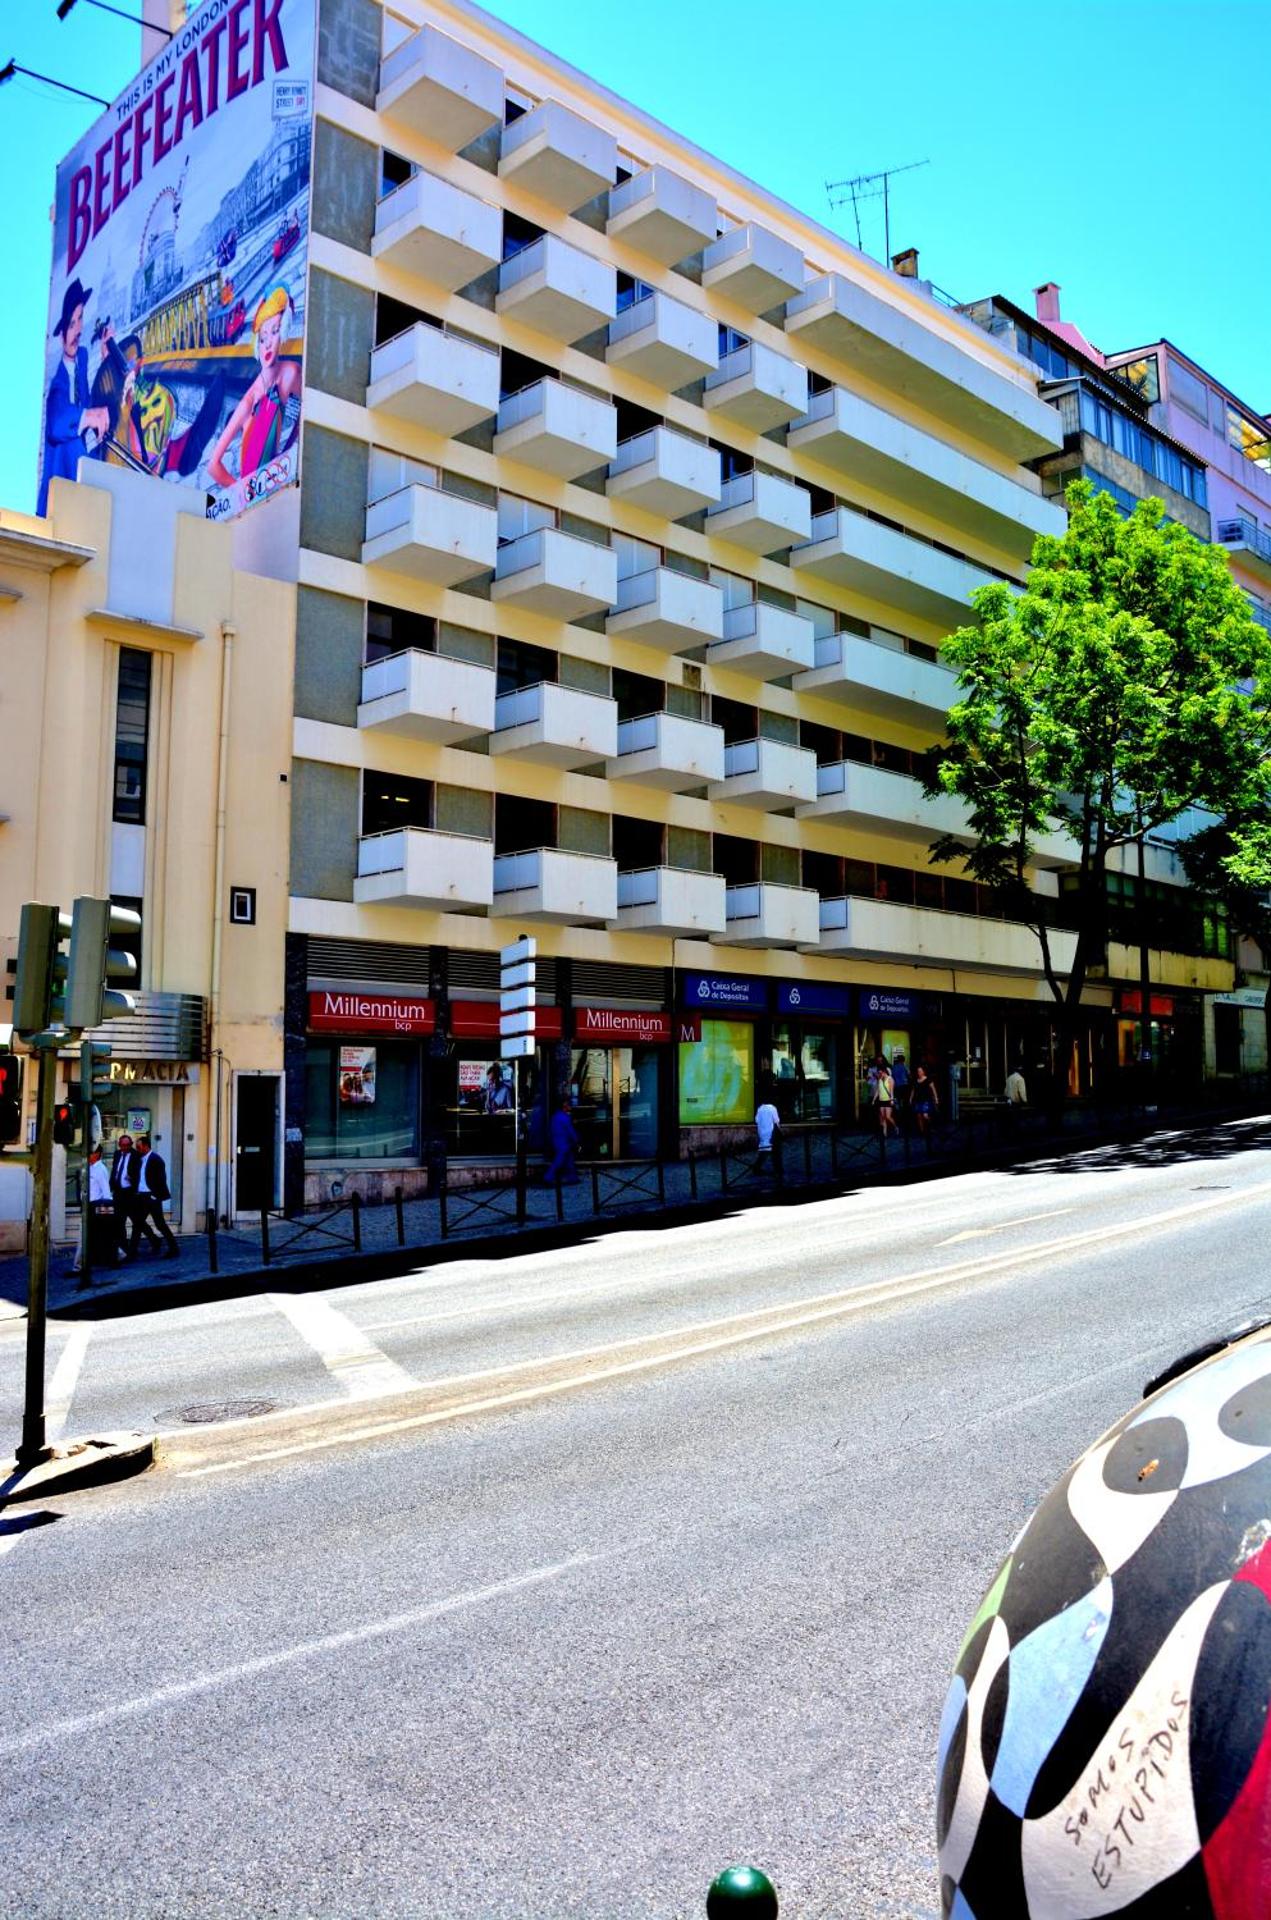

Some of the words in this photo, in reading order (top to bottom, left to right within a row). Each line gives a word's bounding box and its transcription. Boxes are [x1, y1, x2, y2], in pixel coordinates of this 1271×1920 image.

[115, 88, 141, 121] THIS
[143, 71, 153, 94] IS
[155, 51, 173, 80] MY
[175, 0, 230, 58] LONDON
[66, 0, 289, 277] BEEFEATER
[711, 981, 731, 991] Caixa
[731, 982, 750, 992] Geral
[711, 991, 719, 999] de
[324, 992, 425, 1019] Millennium
[394, 1019, 412, 1032] bcp
[586, 1008, 663, 1031] Millennium
[640, 1031, 654, 1041] bcp
[681, 1023, 695, 1041] M
[1065, 1727, 1137, 1846] SOMOS
